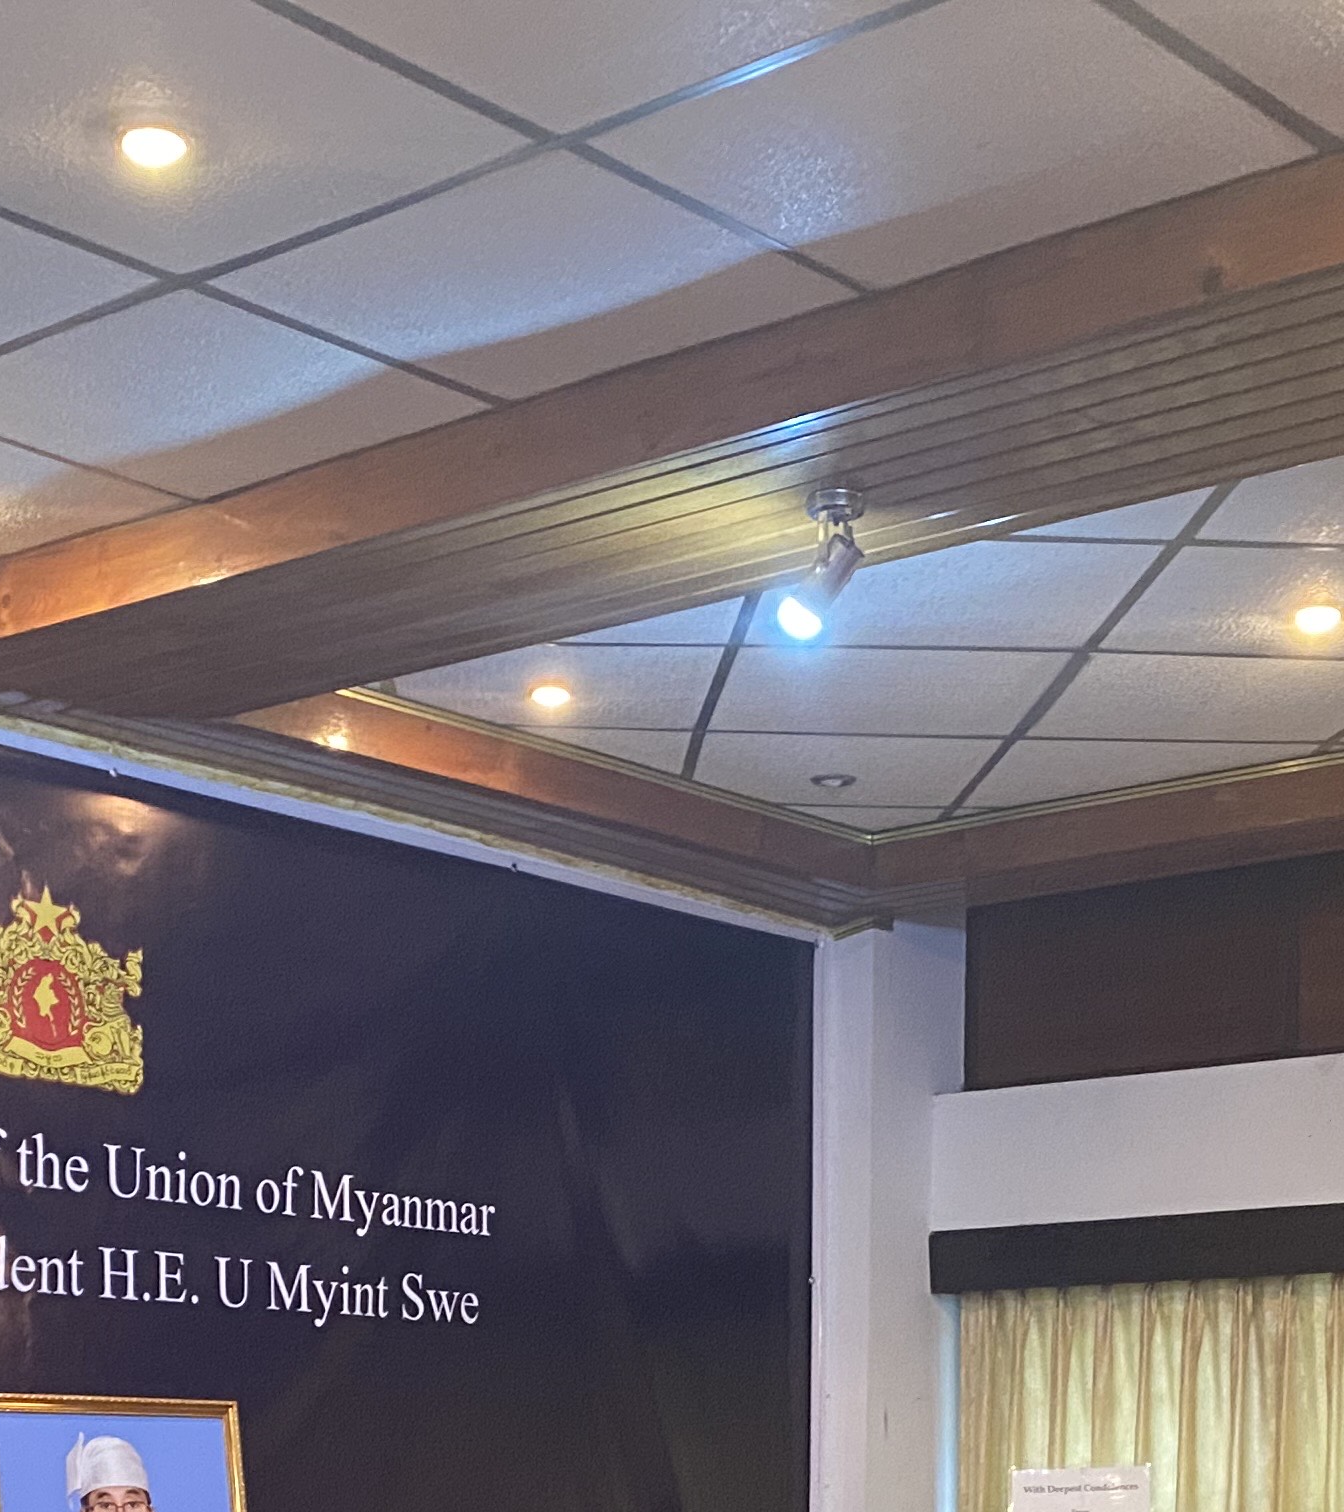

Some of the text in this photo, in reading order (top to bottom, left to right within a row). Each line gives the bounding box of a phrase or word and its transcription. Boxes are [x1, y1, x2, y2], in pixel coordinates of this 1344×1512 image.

[16, 1132, 89, 1193] the
[103, 1143, 243, 1211] Union
[256, 1165, 304, 1217] of
[310, 1170, 496, 1237] Myanmar
[98, 1246, 199, 1305] H.E.
[214, 1256, 253, 1308] U
[266, 1261, 389, 1328] Myint
[401, 1272, 479, 1325] Swe
[1023, 1485, 1046, 1493] With
